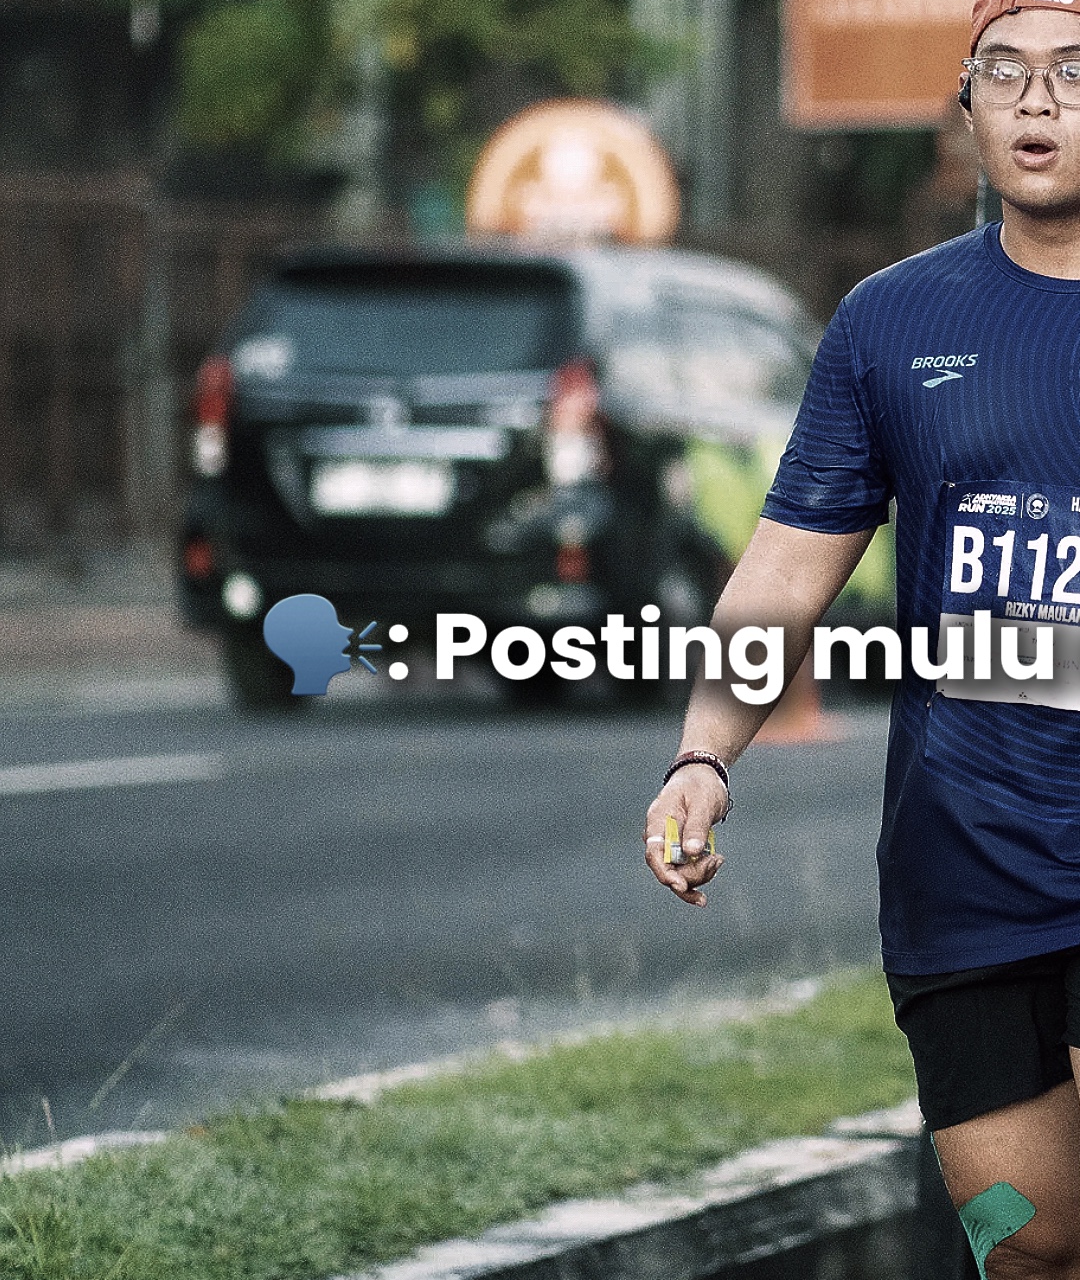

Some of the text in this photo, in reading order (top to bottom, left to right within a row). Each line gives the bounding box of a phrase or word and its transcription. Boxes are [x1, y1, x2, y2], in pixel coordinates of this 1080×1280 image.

[911, 353, 979, 370] BROOKS
[957, 502, 986, 514] RUN
[986, 505, 1017, 516] 2025
[1004, 600, 1037, 619] RIZKY
